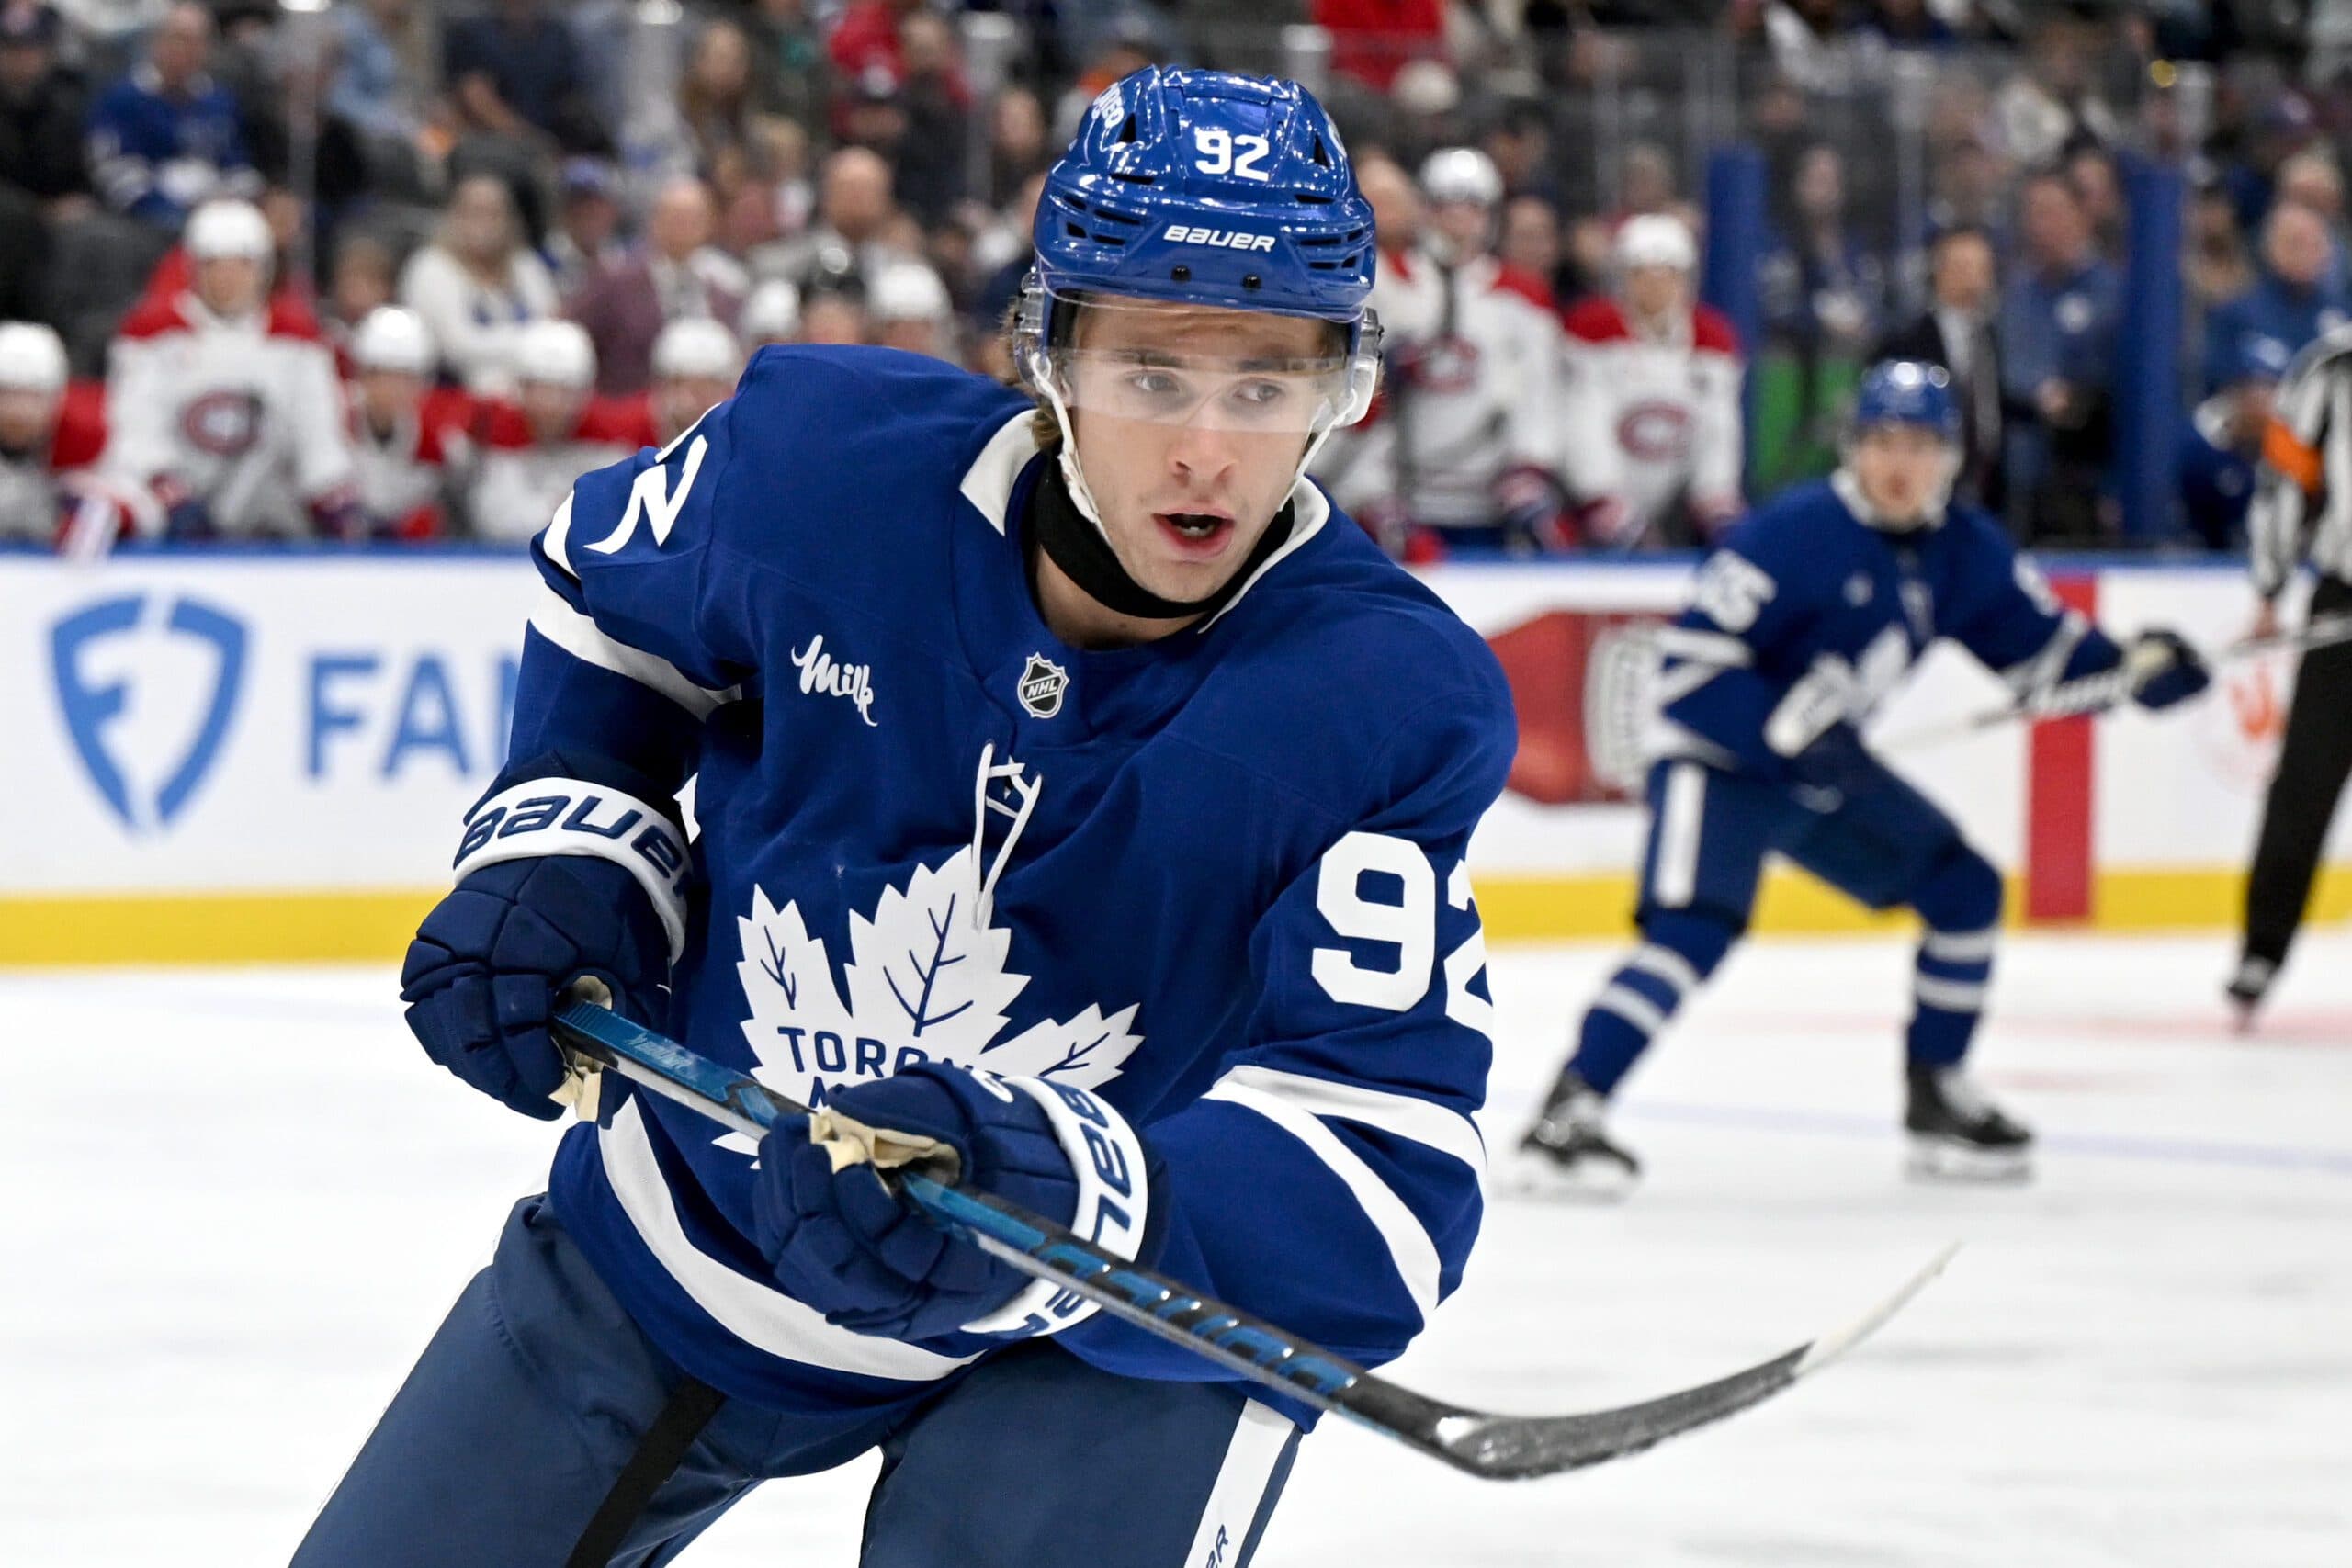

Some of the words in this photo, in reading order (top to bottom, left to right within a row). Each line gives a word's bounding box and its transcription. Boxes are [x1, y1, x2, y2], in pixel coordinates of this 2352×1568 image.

[1195, 130, 1270, 182] 92
[1163, 224, 1276, 253] BAUER
[790, 634, 879, 728] Milk
[1026, 678, 1058, 698] NHL
[453, 795, 687, 897] BAUE
